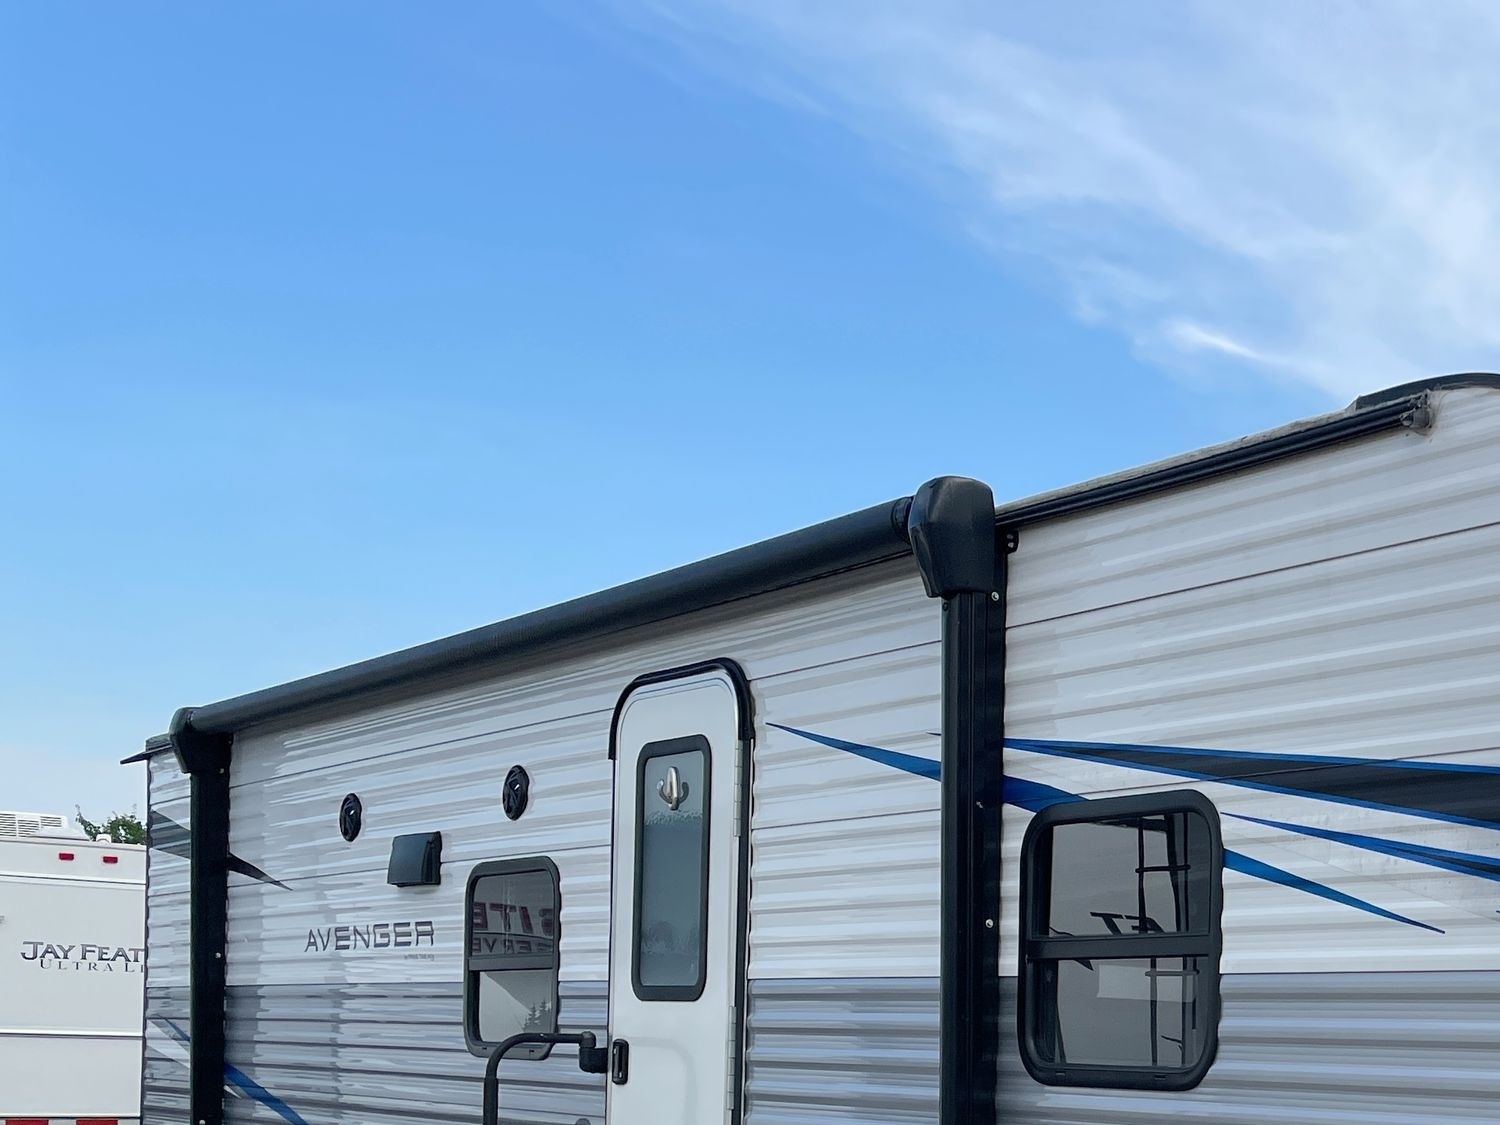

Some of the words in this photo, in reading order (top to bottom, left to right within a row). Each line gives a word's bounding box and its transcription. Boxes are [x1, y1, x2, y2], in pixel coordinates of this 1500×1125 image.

[304, 920, 434, 952] AVENGER
[20, 940, 76, 961] JAY
[40, 959, 114, 973] ULTRA
